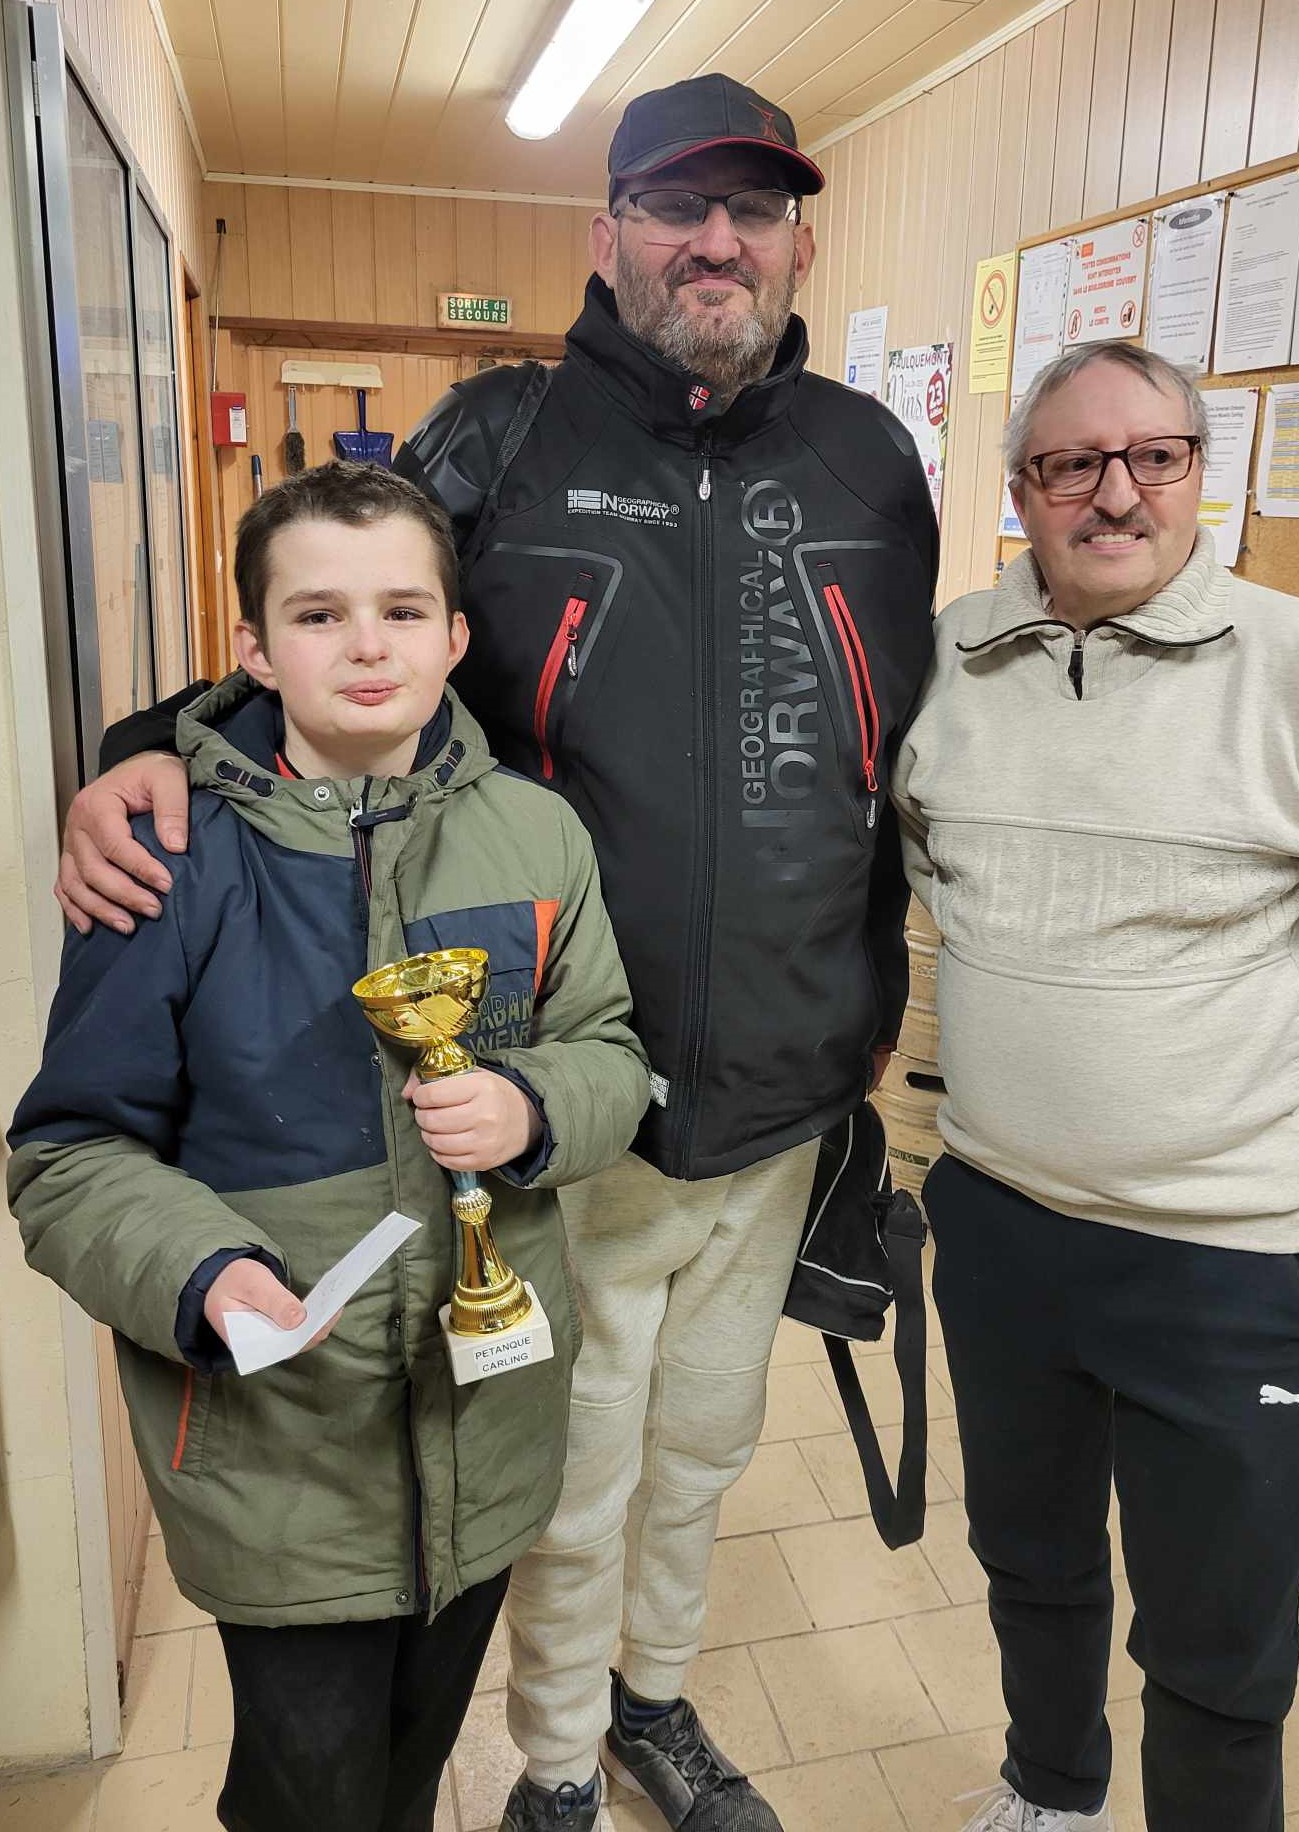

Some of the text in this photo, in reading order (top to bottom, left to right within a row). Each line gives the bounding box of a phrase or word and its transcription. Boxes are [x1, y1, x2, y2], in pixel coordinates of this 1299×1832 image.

[449, 297, 506, 311] SORTIE de
[449, 308, 506, 322] SECOURS
[928, 379, 944, 409] 23
[617, 496, 670, 509] GEOGRAPHICAL
[475, 1336, 532, 1360] PETANQUE
[482, 1352, 529, 1372] CARLING
